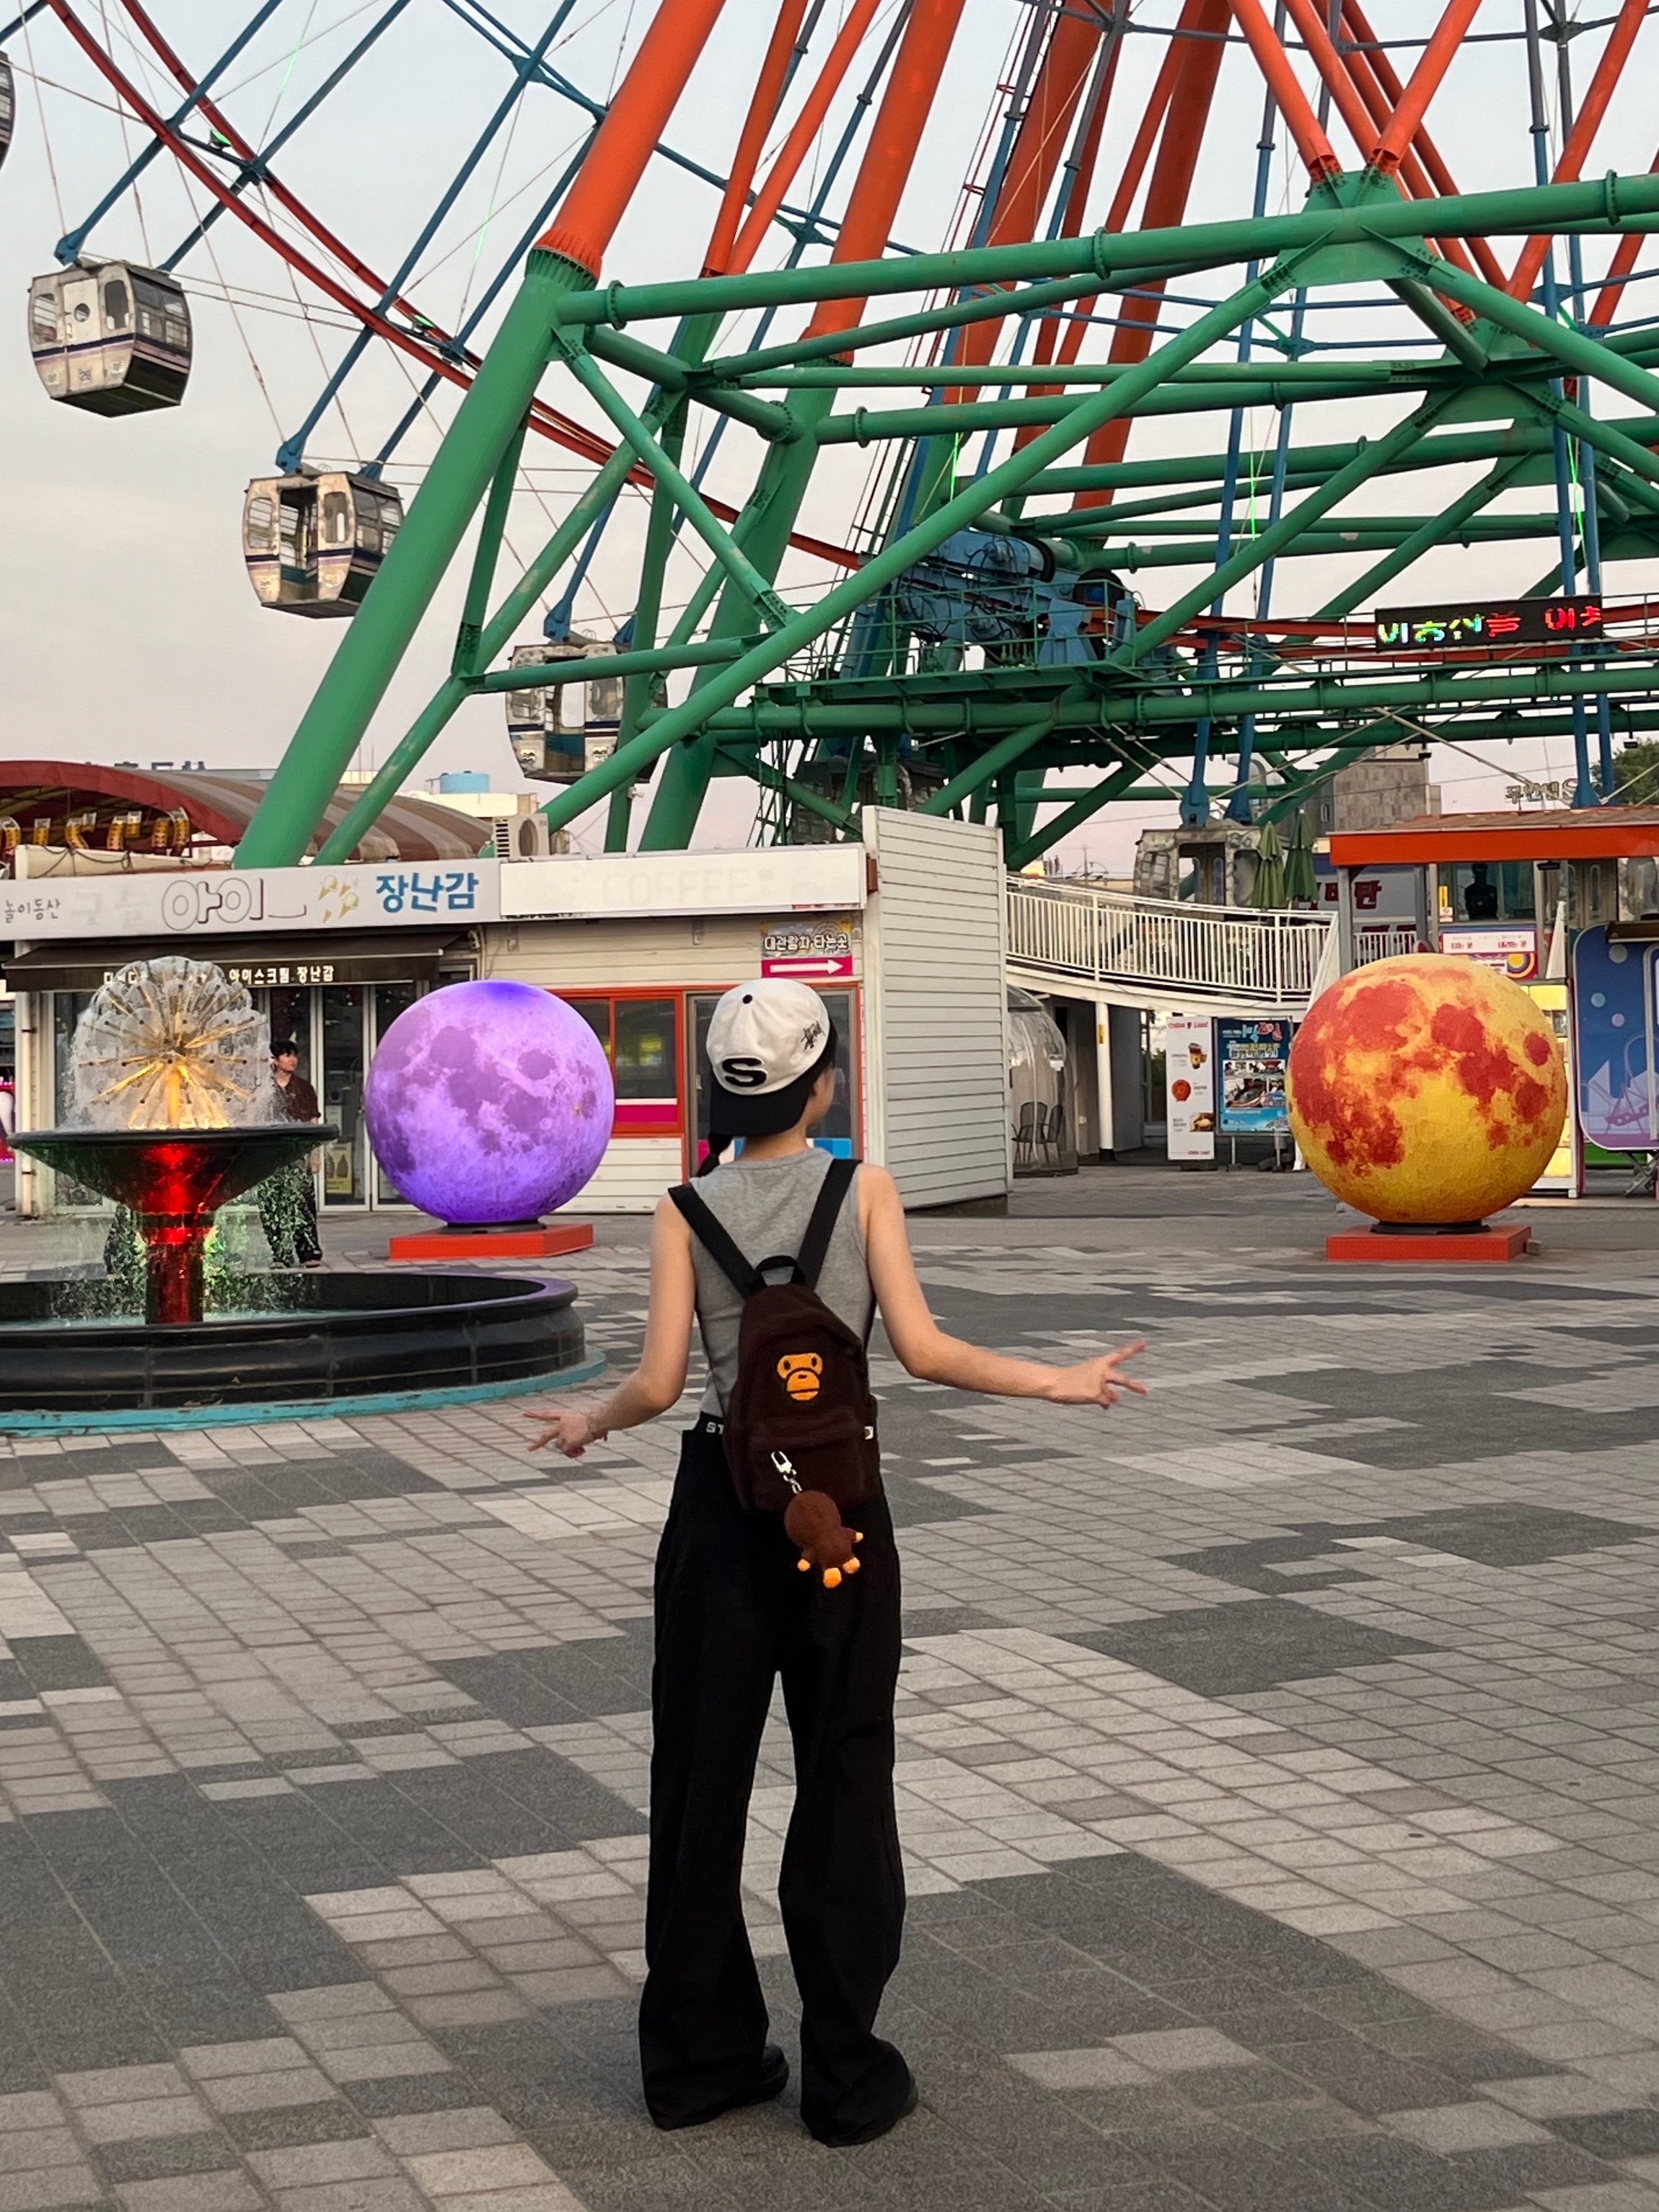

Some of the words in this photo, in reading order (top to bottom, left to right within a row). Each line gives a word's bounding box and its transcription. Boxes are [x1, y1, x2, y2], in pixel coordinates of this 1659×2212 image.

[376, 872, 479, 914] 장난감
[4, 898, 61, 923] 놀이동산
[229, 967, 289, 985] 아이스크림
[296, 965, 334, 984] 장난감
[722, 1057, 767, 1088] S
